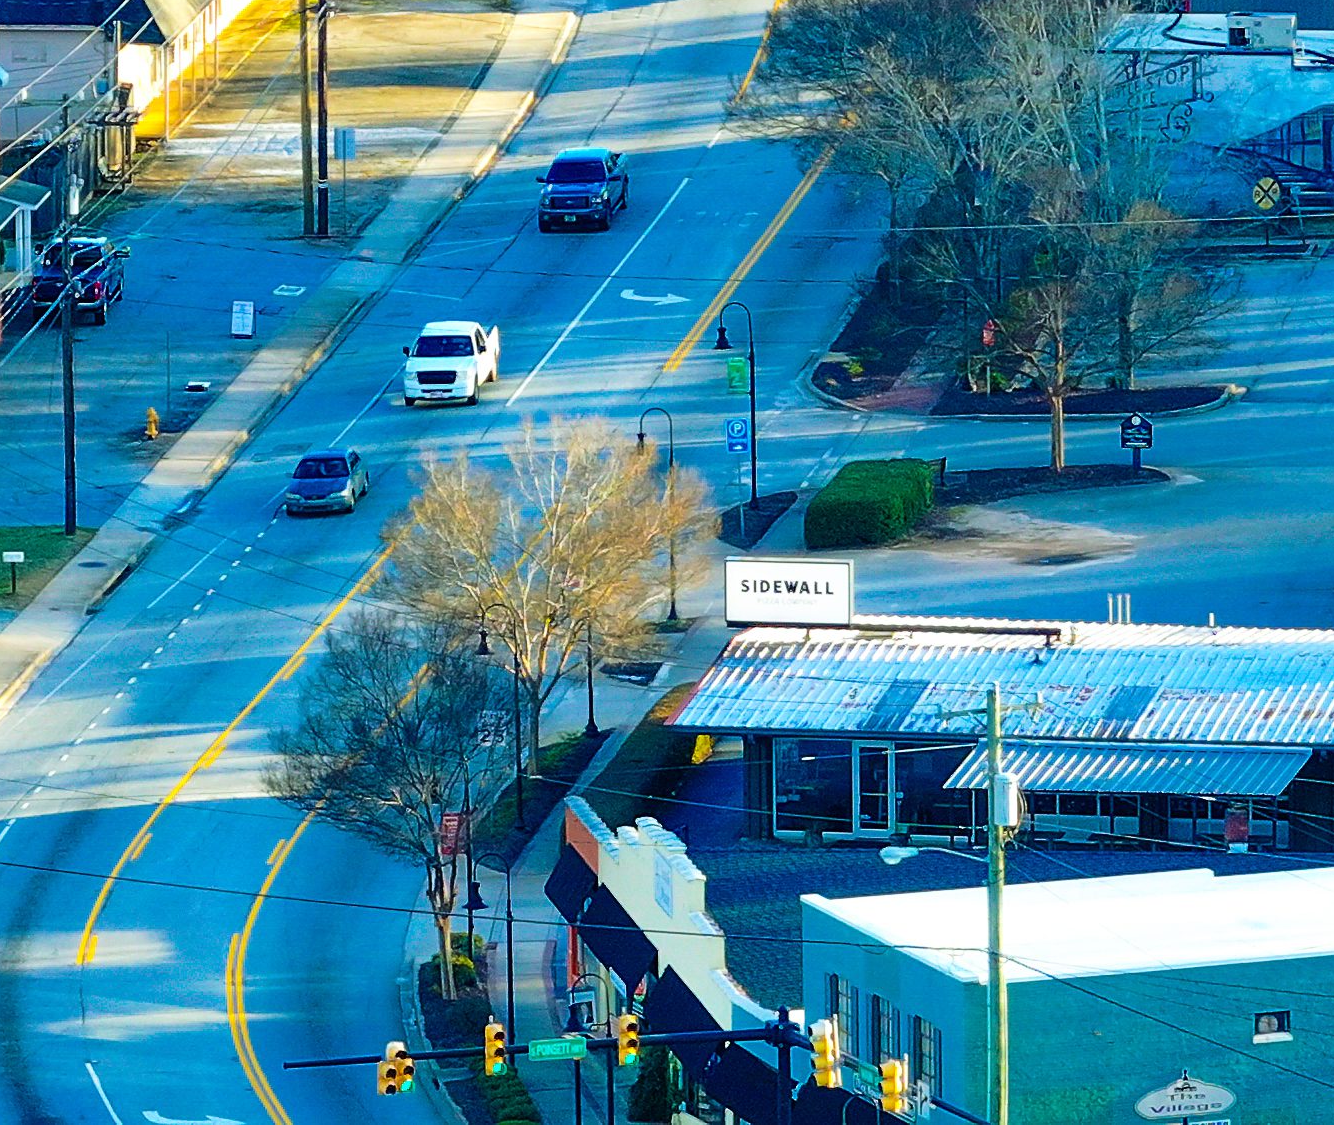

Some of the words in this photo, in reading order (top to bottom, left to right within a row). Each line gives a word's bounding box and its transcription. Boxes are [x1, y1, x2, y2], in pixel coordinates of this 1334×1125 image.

[740, 579, 835, 595] SIDEWALL
[1170, 1093, 1206, 1102] The
[1151, 1102, 1222, 1114] Village
